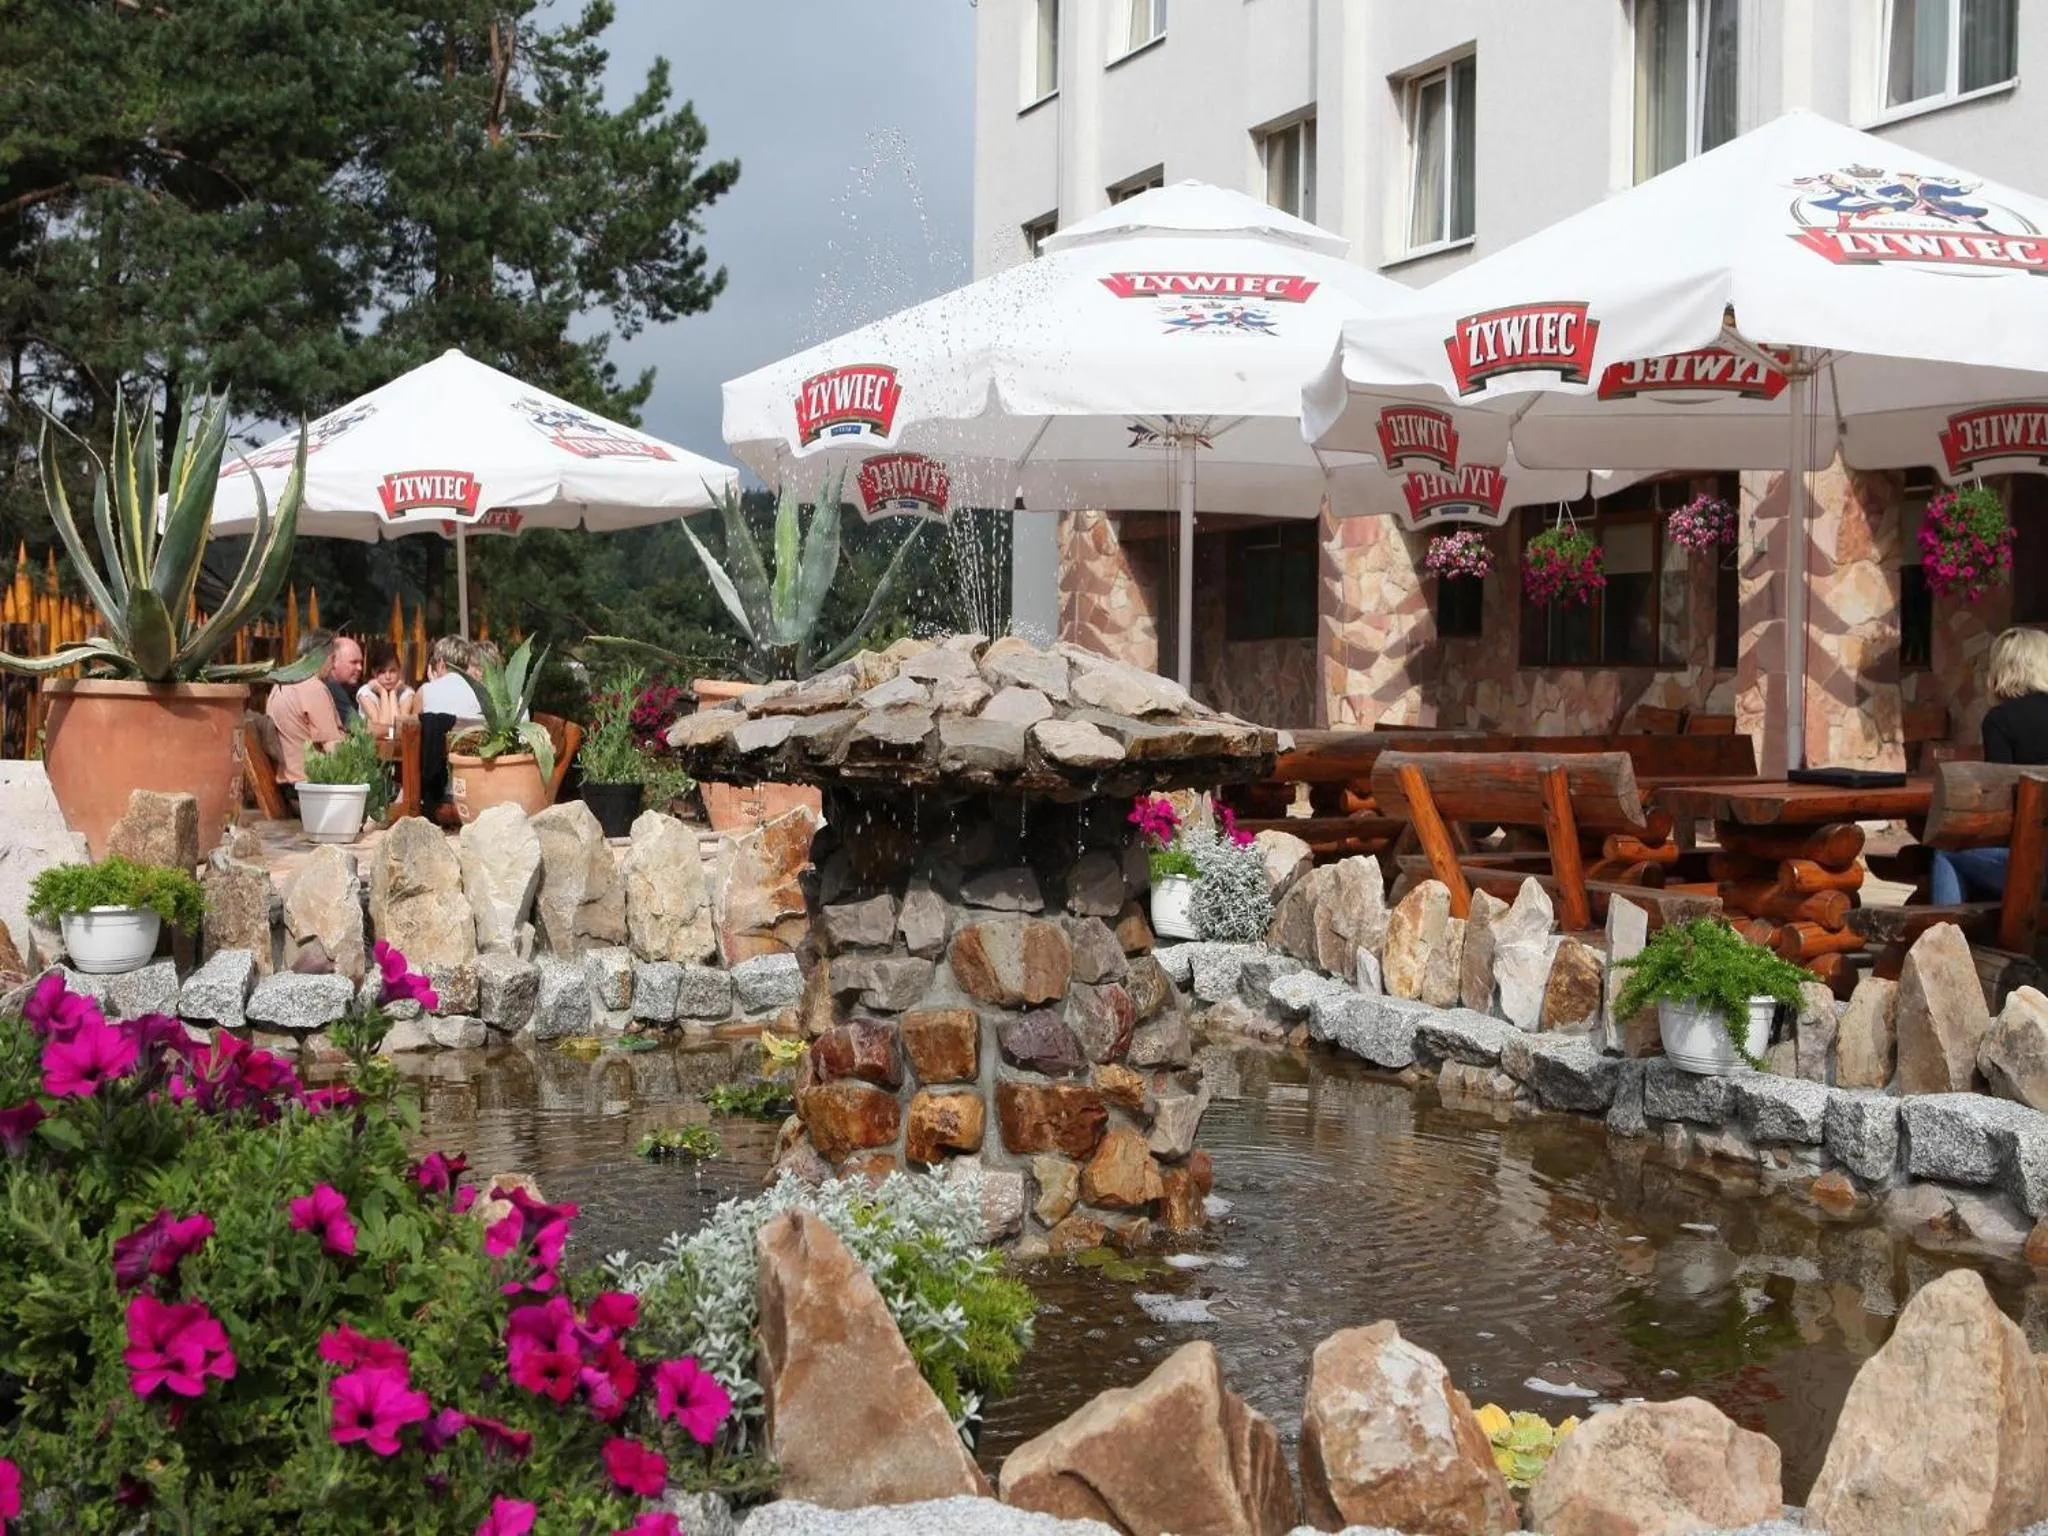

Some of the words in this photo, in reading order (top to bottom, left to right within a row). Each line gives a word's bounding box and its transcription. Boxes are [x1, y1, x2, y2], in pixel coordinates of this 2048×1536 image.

[1466, 312, 1577, 368] ŻYWIEC
[807, 374, 889, 420] ŻYWIEC
[391, 475, 468, 503] ŻYWIEC
